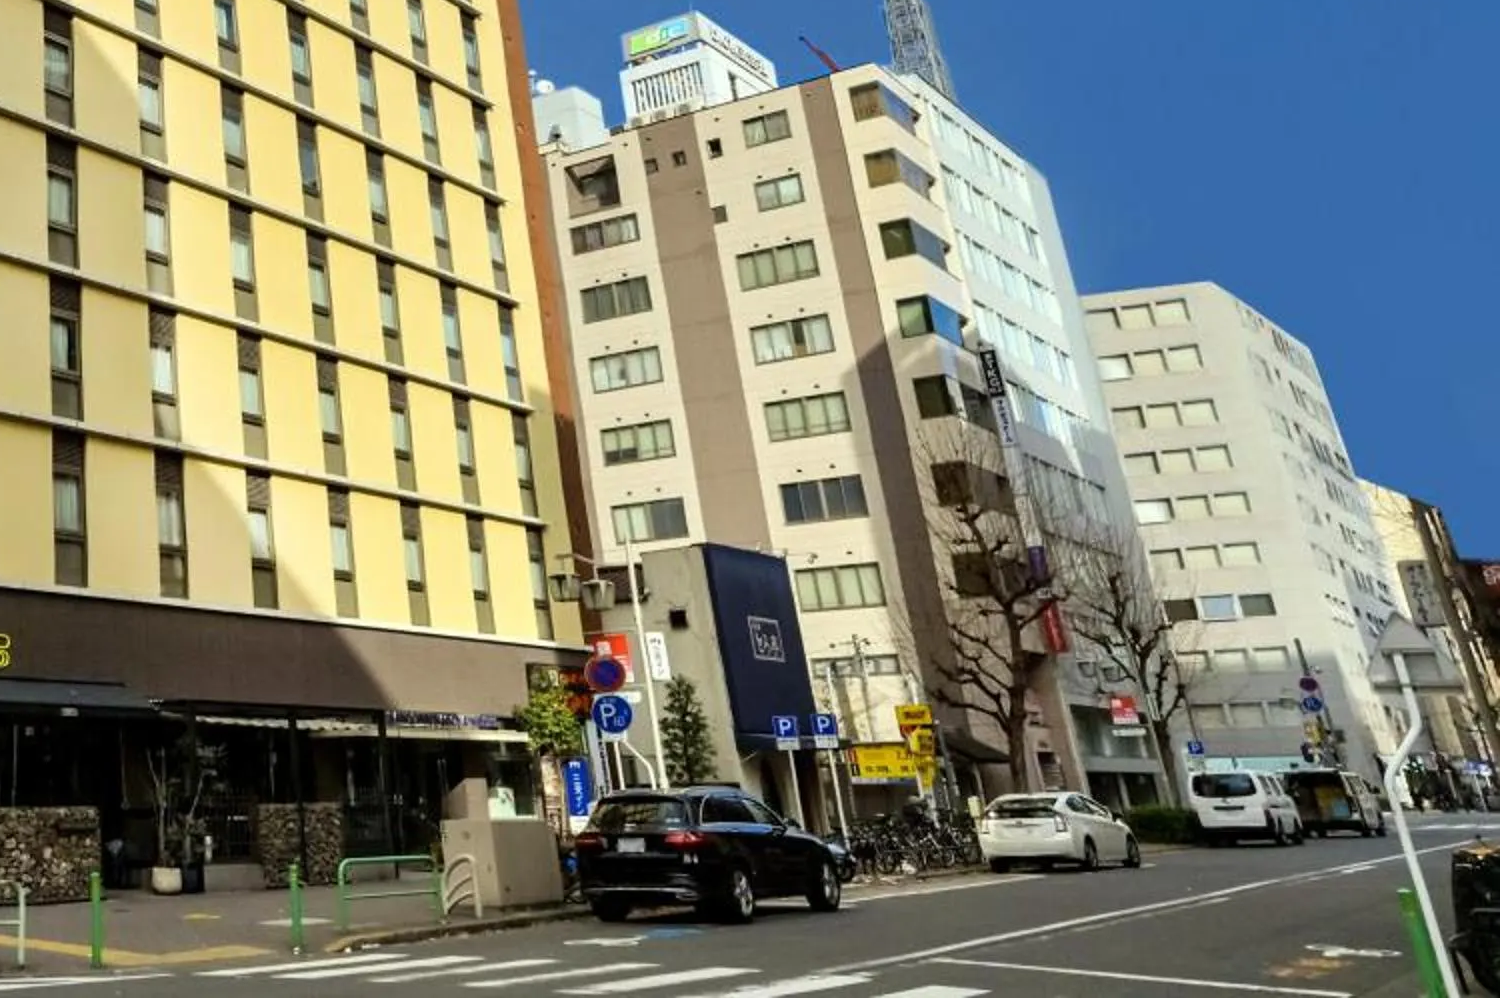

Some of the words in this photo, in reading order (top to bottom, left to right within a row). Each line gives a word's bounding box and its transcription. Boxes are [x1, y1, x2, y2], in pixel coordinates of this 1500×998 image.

[599, 703, 616, 729] P
[817, 716, 830, 733] P
[779, 719, 791, 736] P
